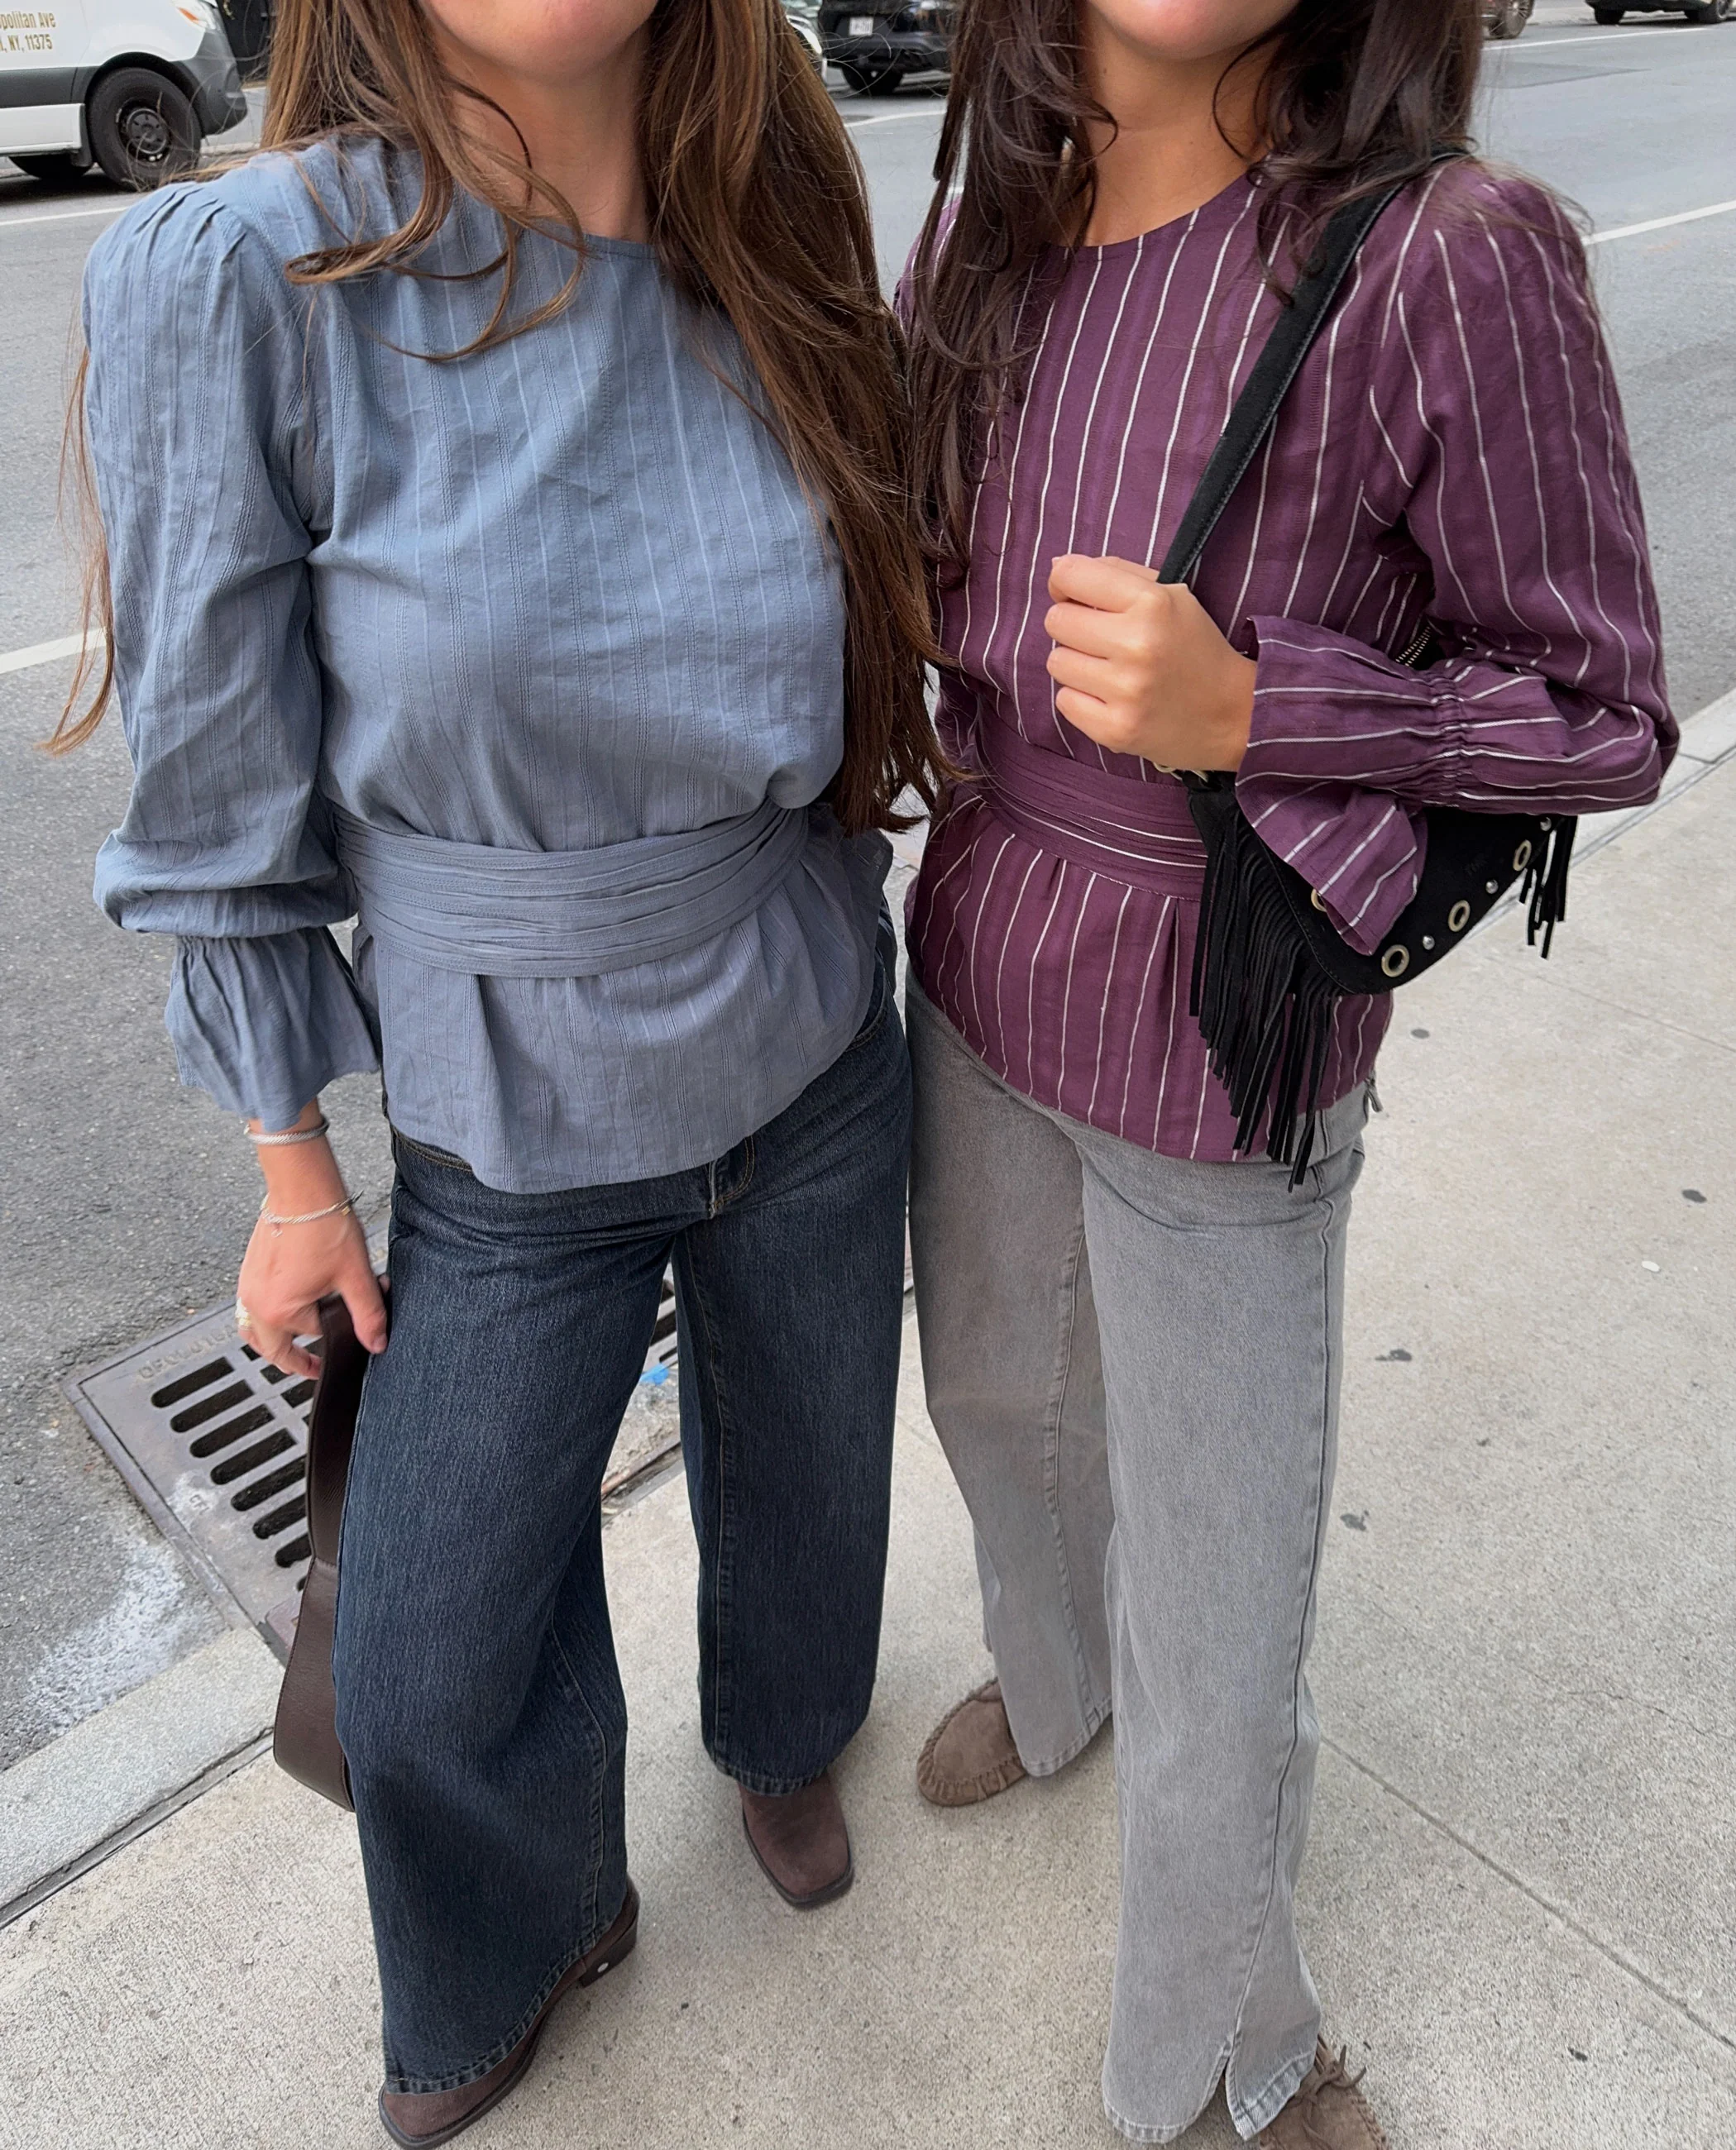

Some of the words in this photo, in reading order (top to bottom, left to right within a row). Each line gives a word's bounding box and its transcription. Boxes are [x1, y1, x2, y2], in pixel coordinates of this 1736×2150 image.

[0, 11, 36, 31] politan
[38, 12, 56, 28] Ave
[7, 35, 25, 52] NY,
[25, 34, 53, 50] 11375
